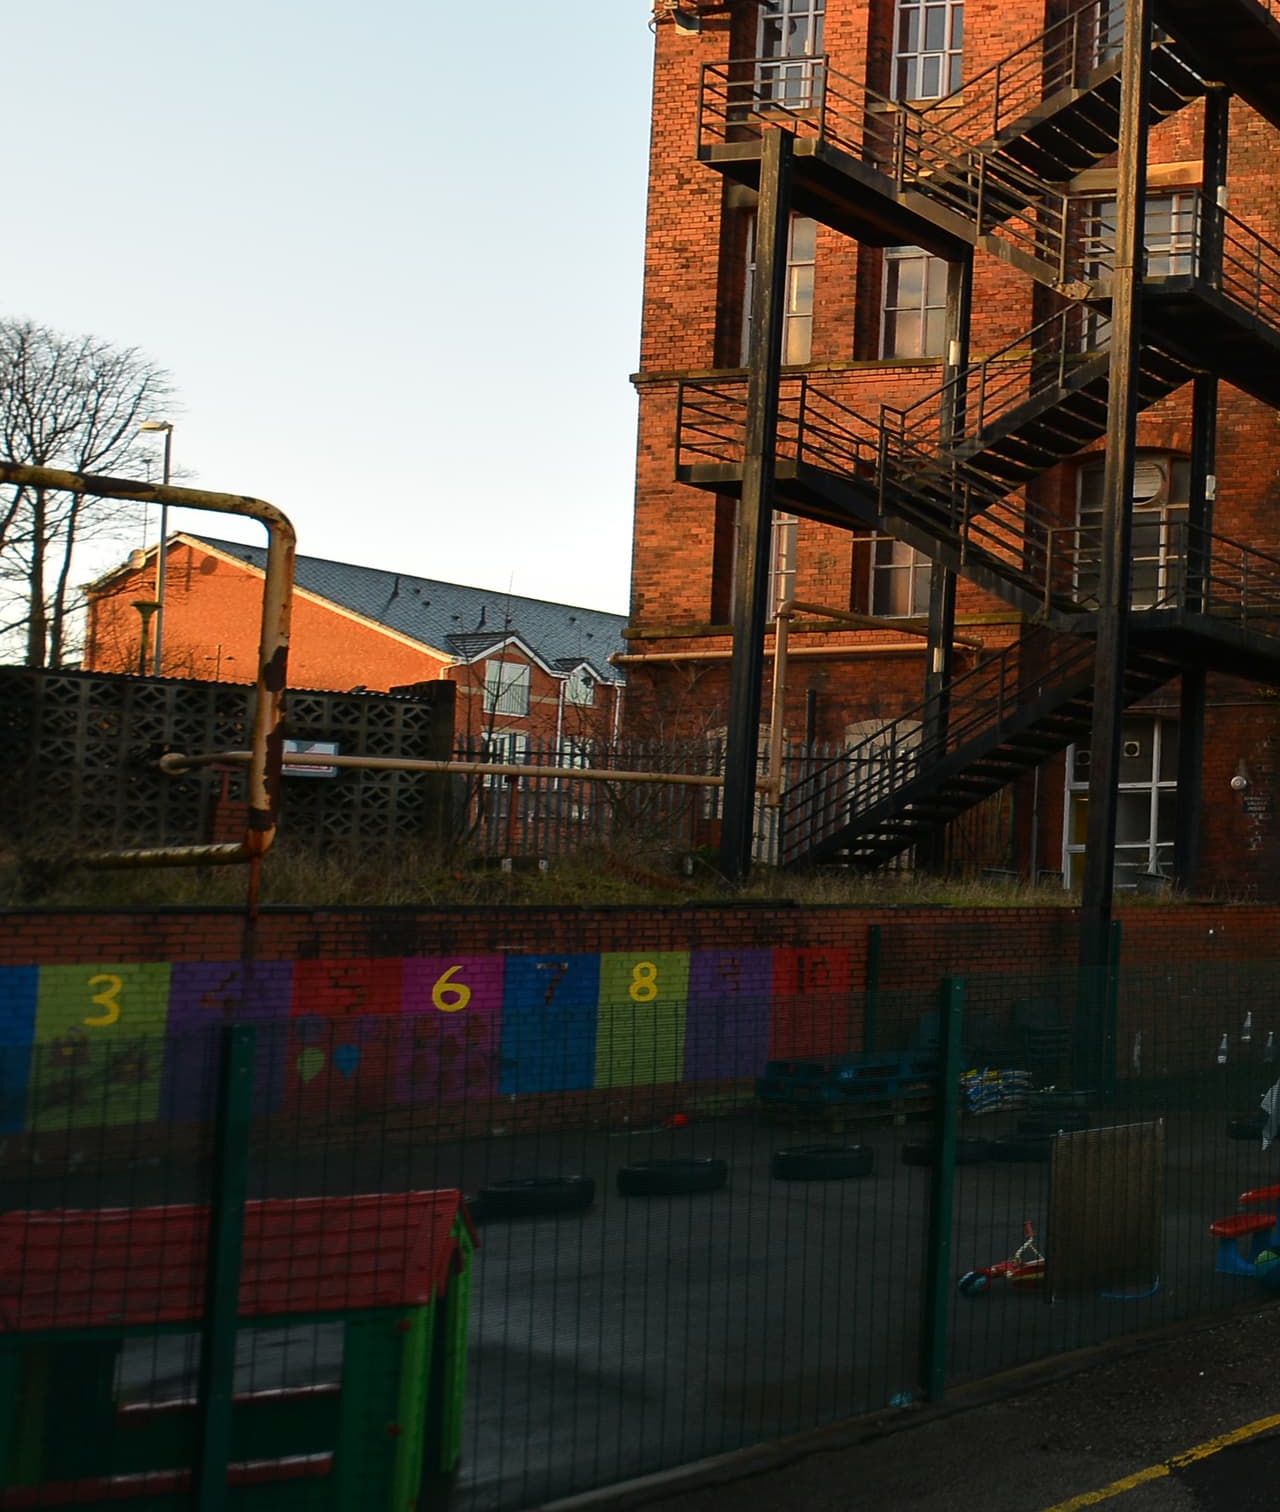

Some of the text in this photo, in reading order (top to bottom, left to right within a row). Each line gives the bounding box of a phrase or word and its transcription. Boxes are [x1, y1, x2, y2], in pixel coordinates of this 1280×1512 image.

[83, 973, 124, 1026] 3
[329, 967, 366, 1013] 5
[432, 965, 471, 1012] 6
[536, 962, 569, 1006] 7
[628, 961, 658, 1002] 8
